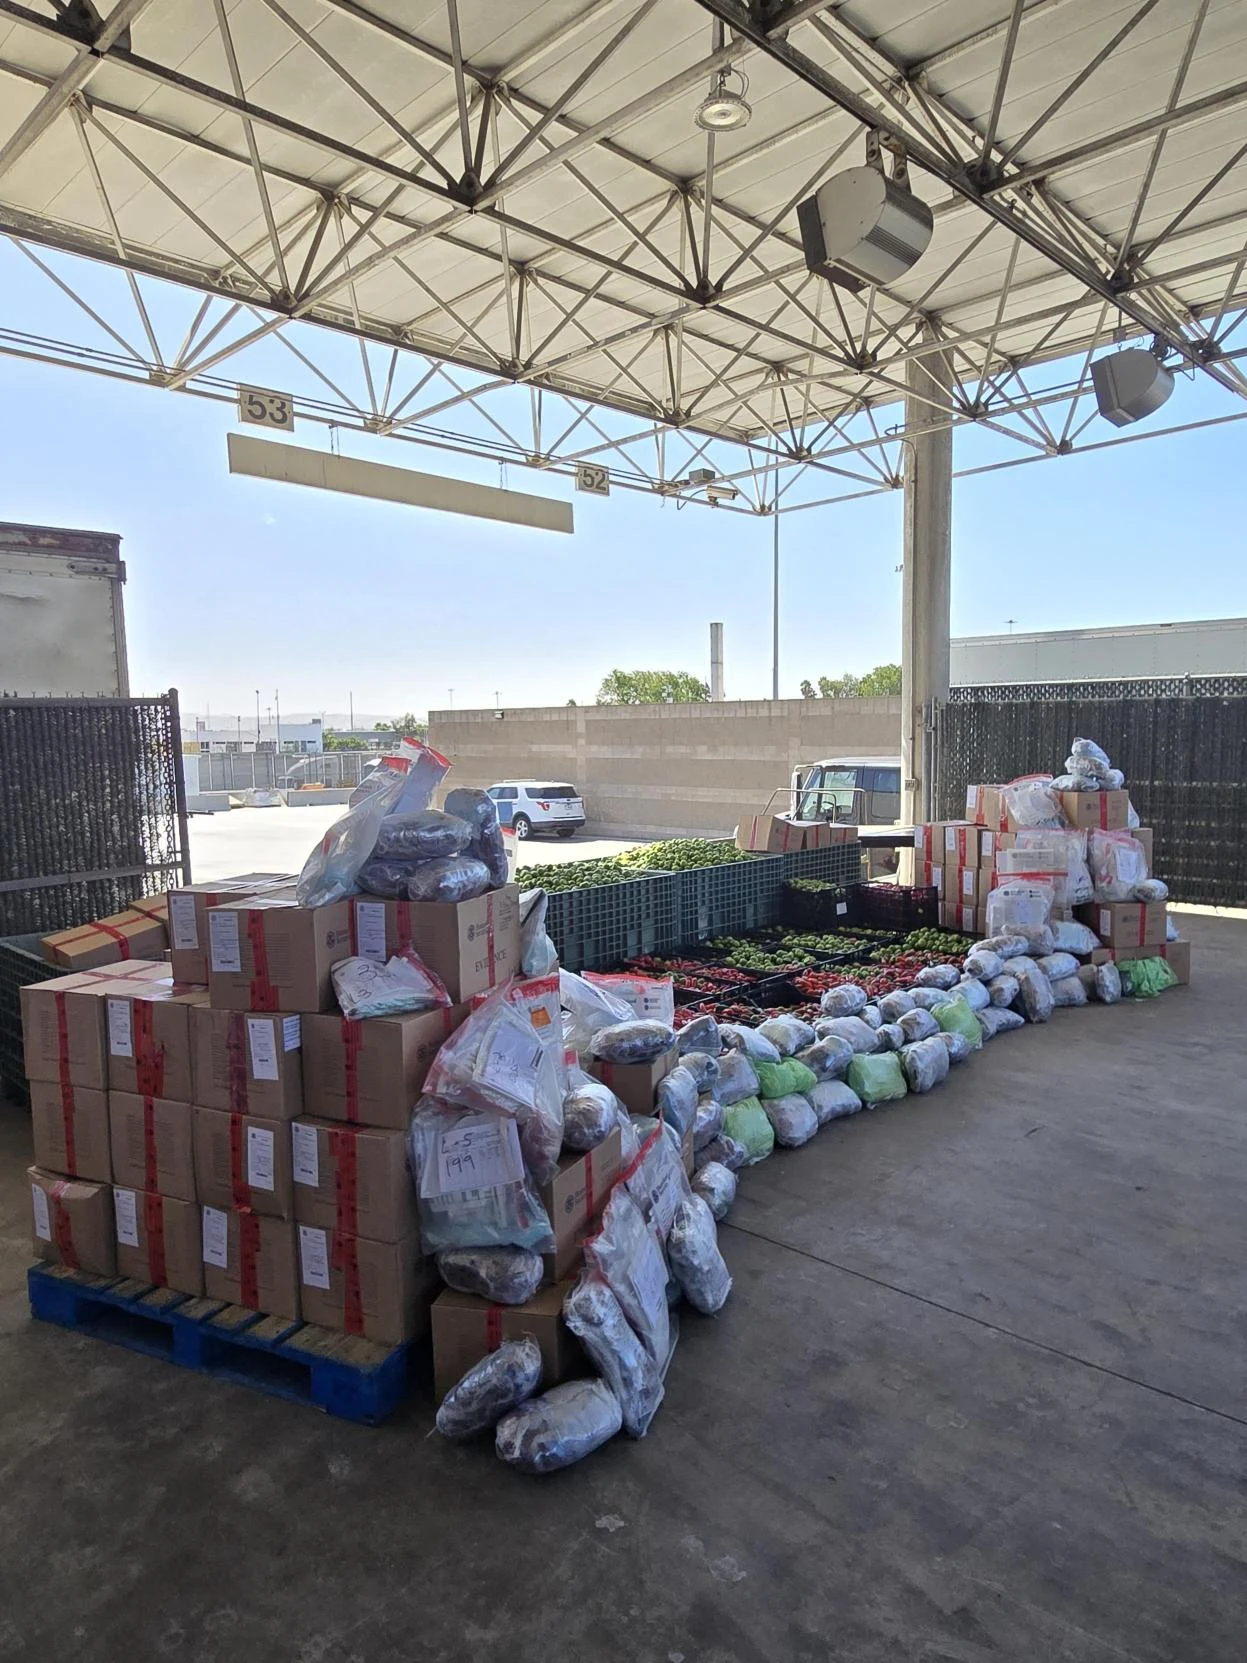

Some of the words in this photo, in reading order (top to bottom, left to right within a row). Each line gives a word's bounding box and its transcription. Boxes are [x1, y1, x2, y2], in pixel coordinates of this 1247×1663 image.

[248, 394, 288, 424] 53
[583, 469, 606, 490] 52
[445, 1155, 475, 1177] 199
